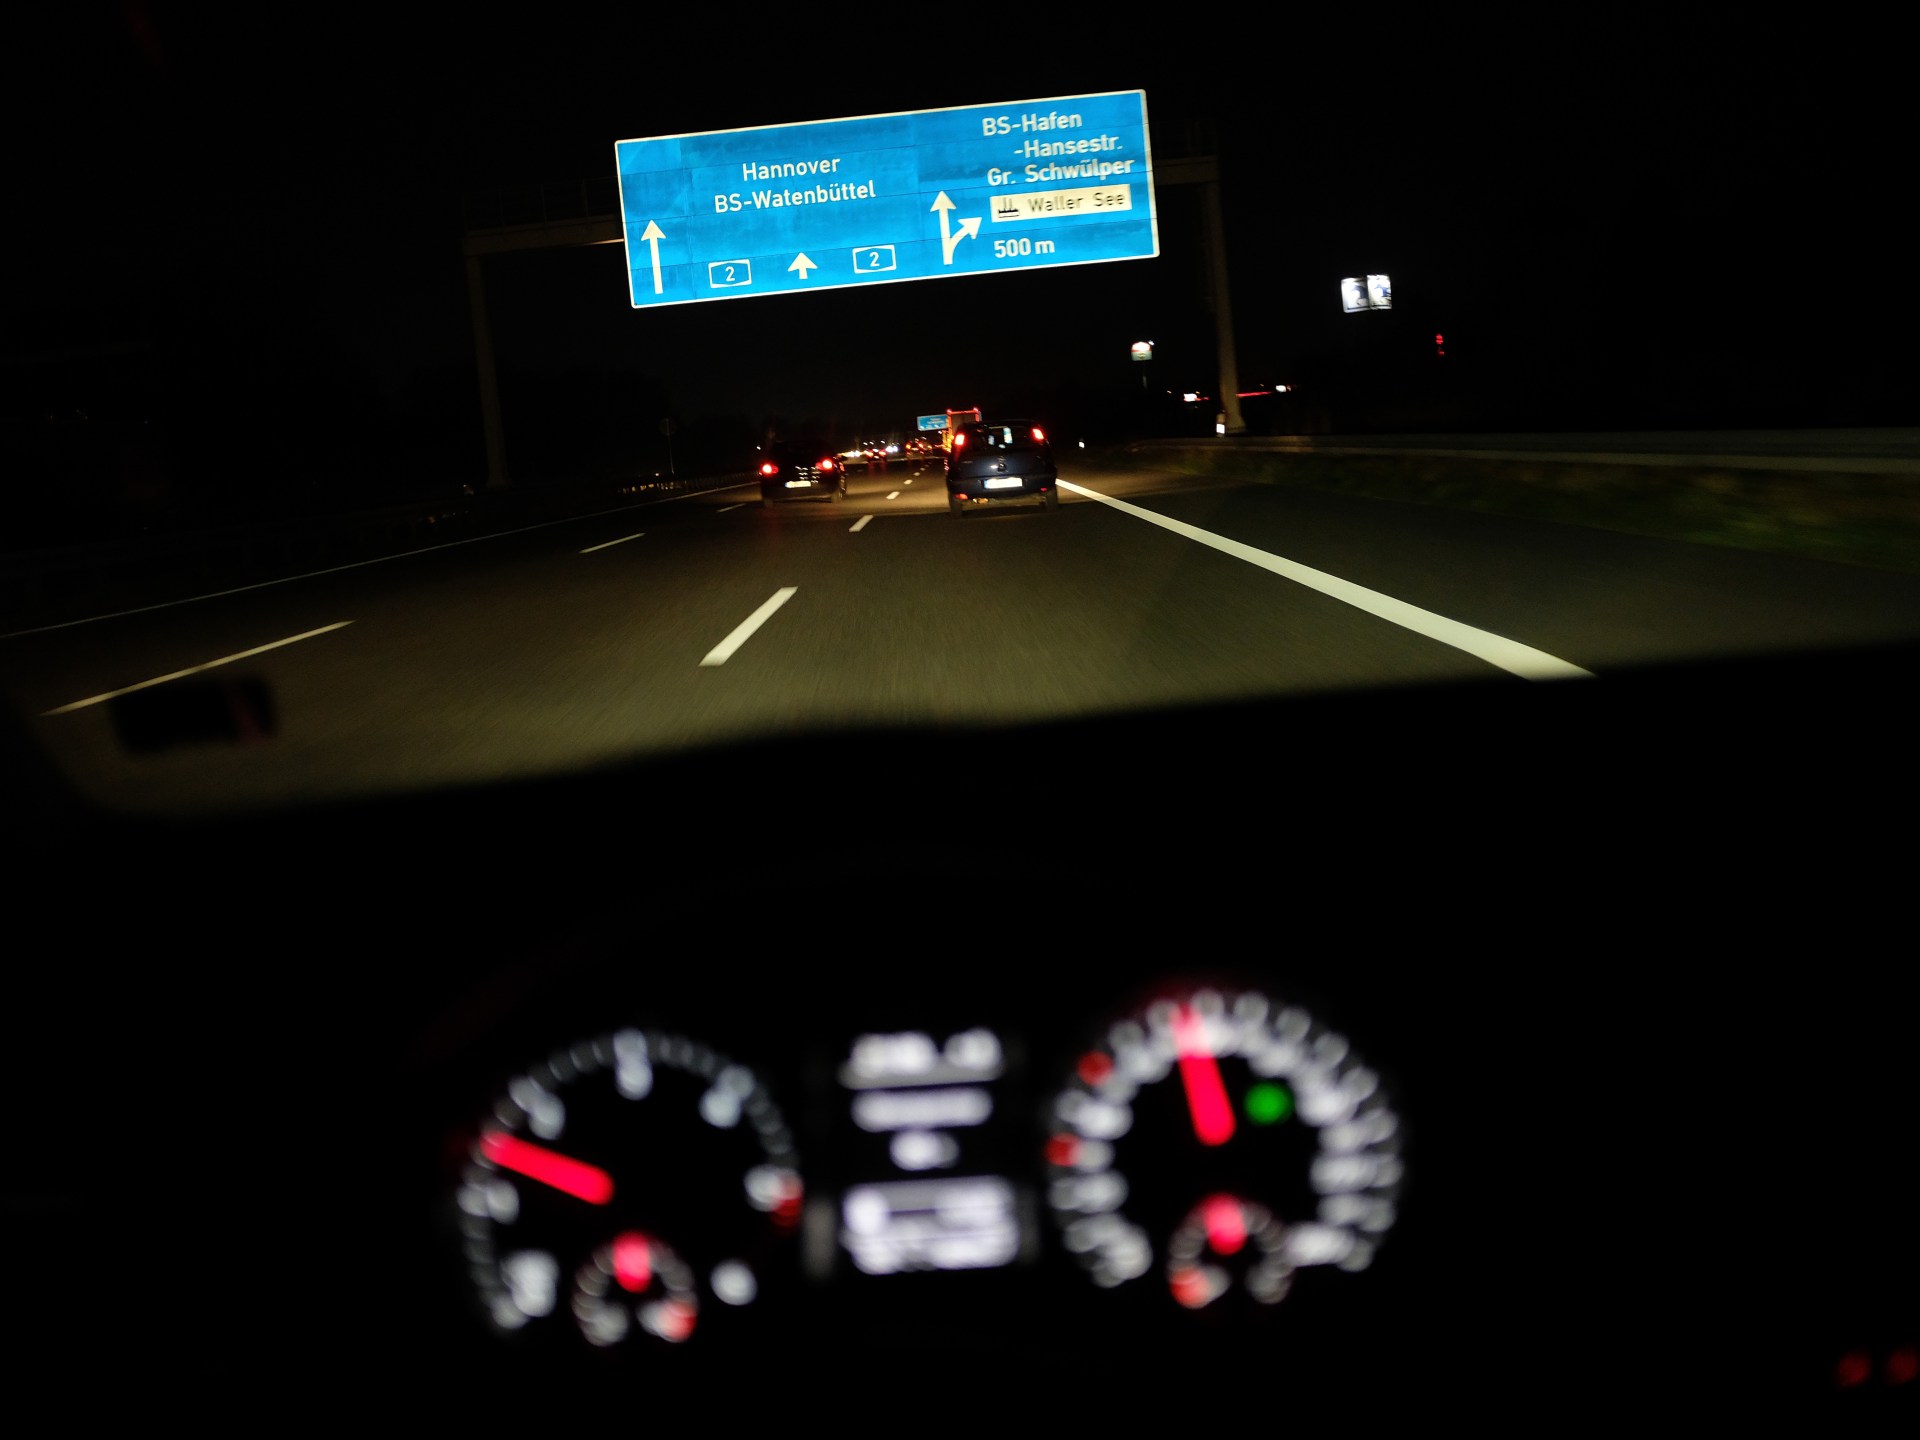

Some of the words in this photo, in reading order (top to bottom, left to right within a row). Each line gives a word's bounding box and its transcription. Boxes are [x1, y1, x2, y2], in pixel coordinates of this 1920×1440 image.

[982, 111, 1082, 136] BS-Hafen
[1013, 134, 1123, 158] -Hansestr.
[742, 158, 841, 182] Hannover
[987, 168, 1017, 186] Gr.
[1025, 158, 1135, 183] Schwülper
[715, 180, 876, 213] BS-Watenbüttel
[1028, 196, 1083, 213] Waller
[1093, 191, 1126, 207] See
[869, 251, 880, 267] 2
[994, 238, 1031, 258] 500
[1035, 239, 1055, 254] m
[725, 266, 735, 282] 2
